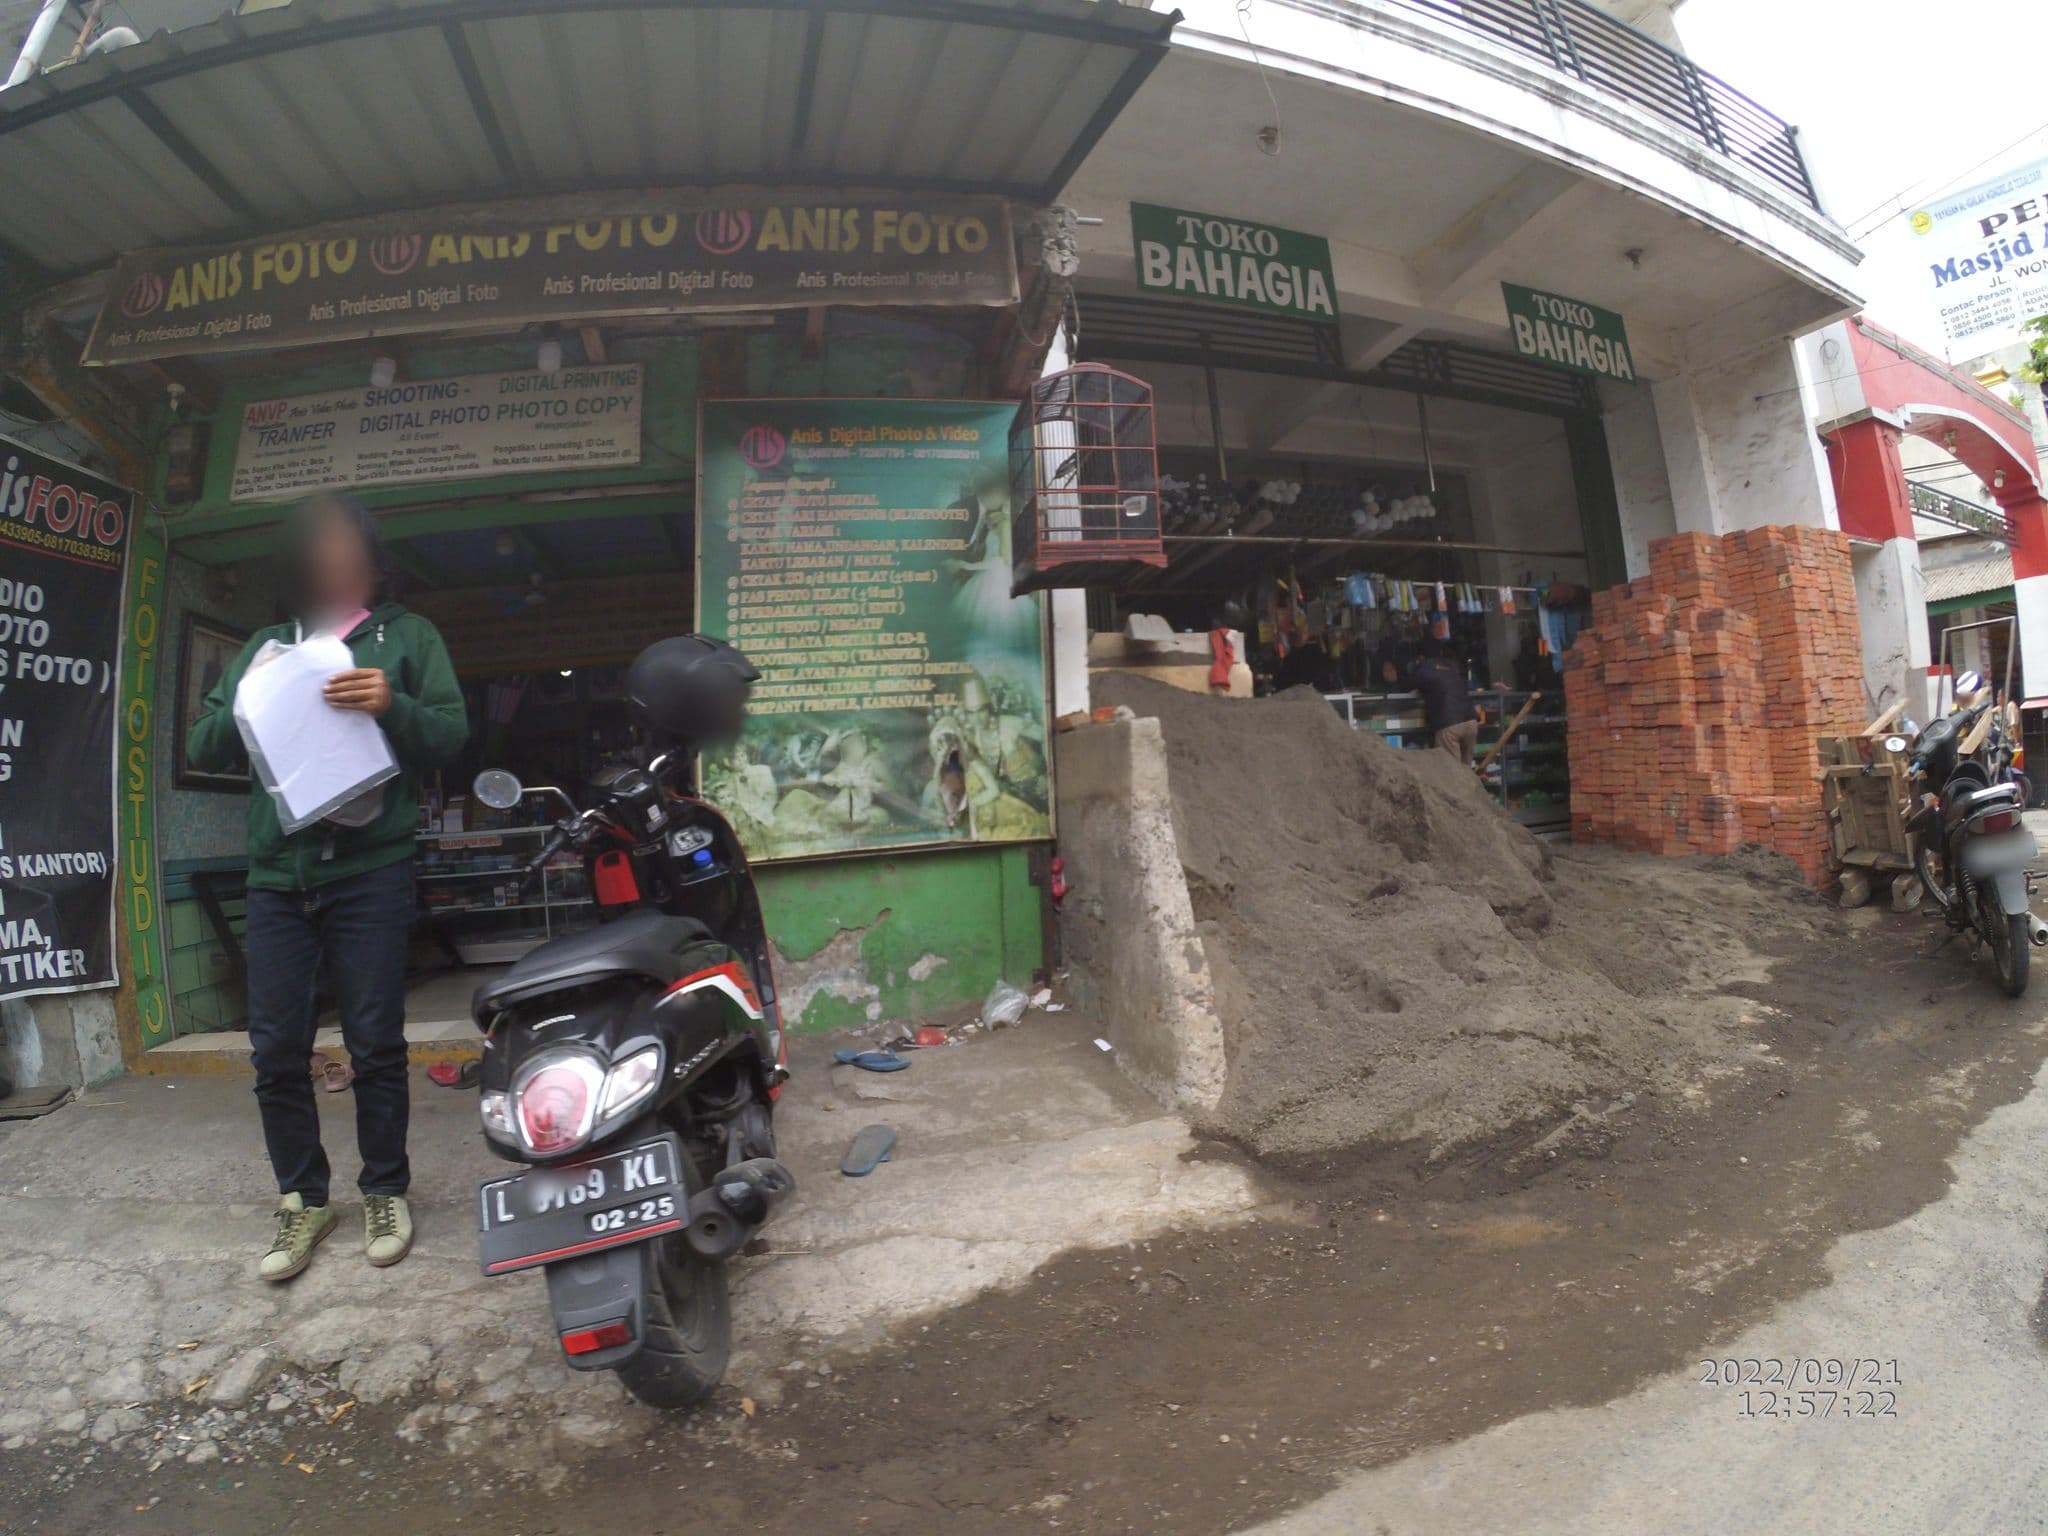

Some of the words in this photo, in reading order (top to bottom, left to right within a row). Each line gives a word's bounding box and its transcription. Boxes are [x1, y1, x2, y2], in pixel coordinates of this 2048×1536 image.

[756, 206, 860, 253] ANIS
[872, 210, 989, 254] FOTO
[1176, 216, 1280, 257] TOKO
[164, 251, 242, 312] ANIS
[253, 236, 357, 290] FOTO
[1930, 231, 2034, 288] Masjid
[543, 277, 574, 296] Anis
[581, 271, 662, 293] Profesional
[668, 271, 714, 294] Digital
[721, 271, 754, 289] Foto
[797, 271, 827, 288] Anis
[833, 271, 909, 288] Profesional
[917, 272, 960, 289] Digital
[964, 271, 996, 286] Foto
[1141, 240, 1334, 316] BAHAGIA
[309, 302, 336, 321] Anis
[340, 290, 412, 316] Profesional
[417, 283, 461, 312] Digital
[466, 283, 499, 302] Foto
[1532, 293, 1595, 329] TOKO
[111, 332, 131, 347] Anis
[135, 321, 202, 343] Profesional
[203, 314, 242, 339] Digital
[245, 313, 272, 330] Foto
[1513, 313, 1633, 380] BAHAGIA
[364, 382, 459, 407] SHOOTING
[499, 373, 561, 394] DIGITAL
[563, 369, 638, 389] PRINTING
[247, 400, 289, 424] ANVP
[360, 411, 424, 433] DIGITAL
[430, 405, 490, 425] PHOTO
[497, 399, 568, 419] PHOTO
[575, 396, 634, 415] COPY
[257, 421, 337, 447] TRANFER
[792, 429, 823, 442] Anis
[830, 426, 877, 447] Digital
[880, 426, 921, 442] Photo
[924, 427, 936, 441] &
[938, 425, 979, 442] Video
[15, 652, 93, 685] FOTO
[744, 654, 807, 667] HOOTING
[18, 851, 107, 880] KANTOR)
[0, 949, 87, 984] TIKER
[497, 1191, 515, 1222] L
[620, 1154, 666, 1192] KL
[590, 1196, 675, 1232] 02-25
